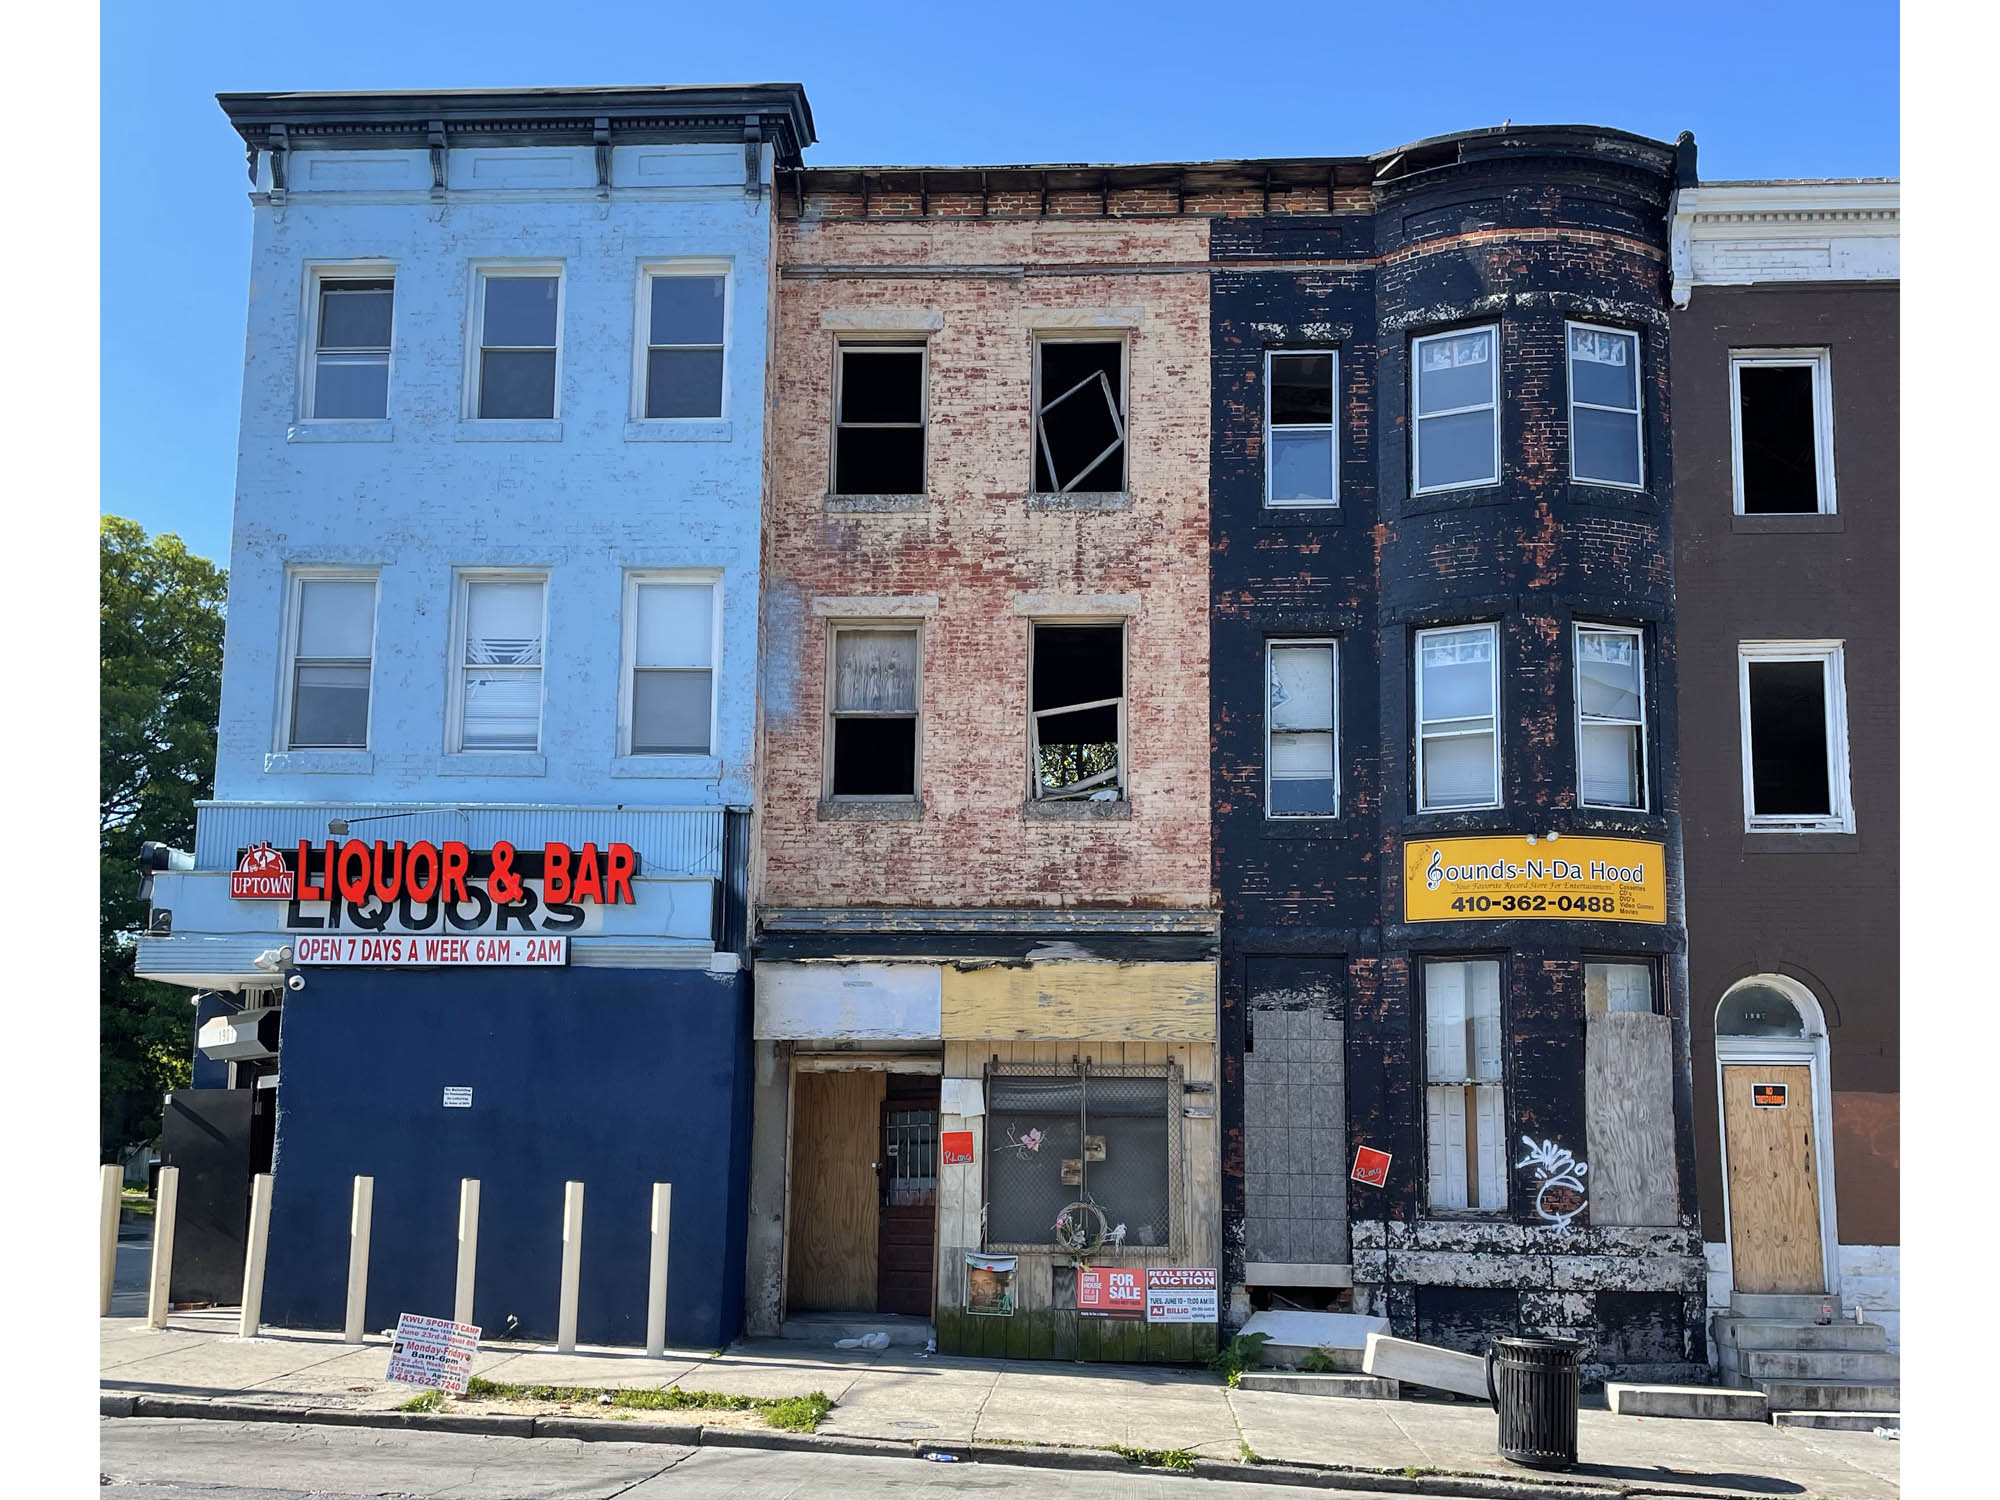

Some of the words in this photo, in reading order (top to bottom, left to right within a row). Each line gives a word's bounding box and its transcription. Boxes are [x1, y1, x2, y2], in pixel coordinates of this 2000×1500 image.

[297, 839, 471, 907] LIQUOR
[487, 840, 524, 904] &
[544, 842, 635, 904] BAR
[1590, 860, 1645, 885] Hood
[233, 876, 291, 894] UPTOWN
[1504, 881, 1528, 890] Record
[1549, 881, 1563, 890] For
[1451, 895, 1616, 913] 410-362-0488
[299, 938, 342, 961] OPEN
[348, 939, 356, 961] 7
[361, 939, 402, 961] DAYS
[408, 940, 418, 961] A
[426, 939, 469, 962] WEEK
[476, 939, 510, 962] 6AM
[526, 939, 560, 962] 2AM
[1765, 1087, 1774, 1095] NO
[1755, 1095, 1785, 1104] TRESPASSING
[1109, 1273, 1134, 1287] FOR
[1150, 1277, 1215, 1285] AUCTION
[1109, 1286, 1141, 1300] SALE
[402, 1315, 424, 1325] KWU
[426, 1319, 459, 1331] SPORTS
[460, 1324, 480, 1335] CAMP
[399, 1329, 420, 1337] June
[421, 1331, 465, 1345] 23rd-August
[406, 1341, 466, 1360] Monday-Friday
[411, 1351, 459, 1365] 8am-6pm
[394, 1373, 460, 1391] 443-622-7240
[432, 1372, 448, 1381] Ages
